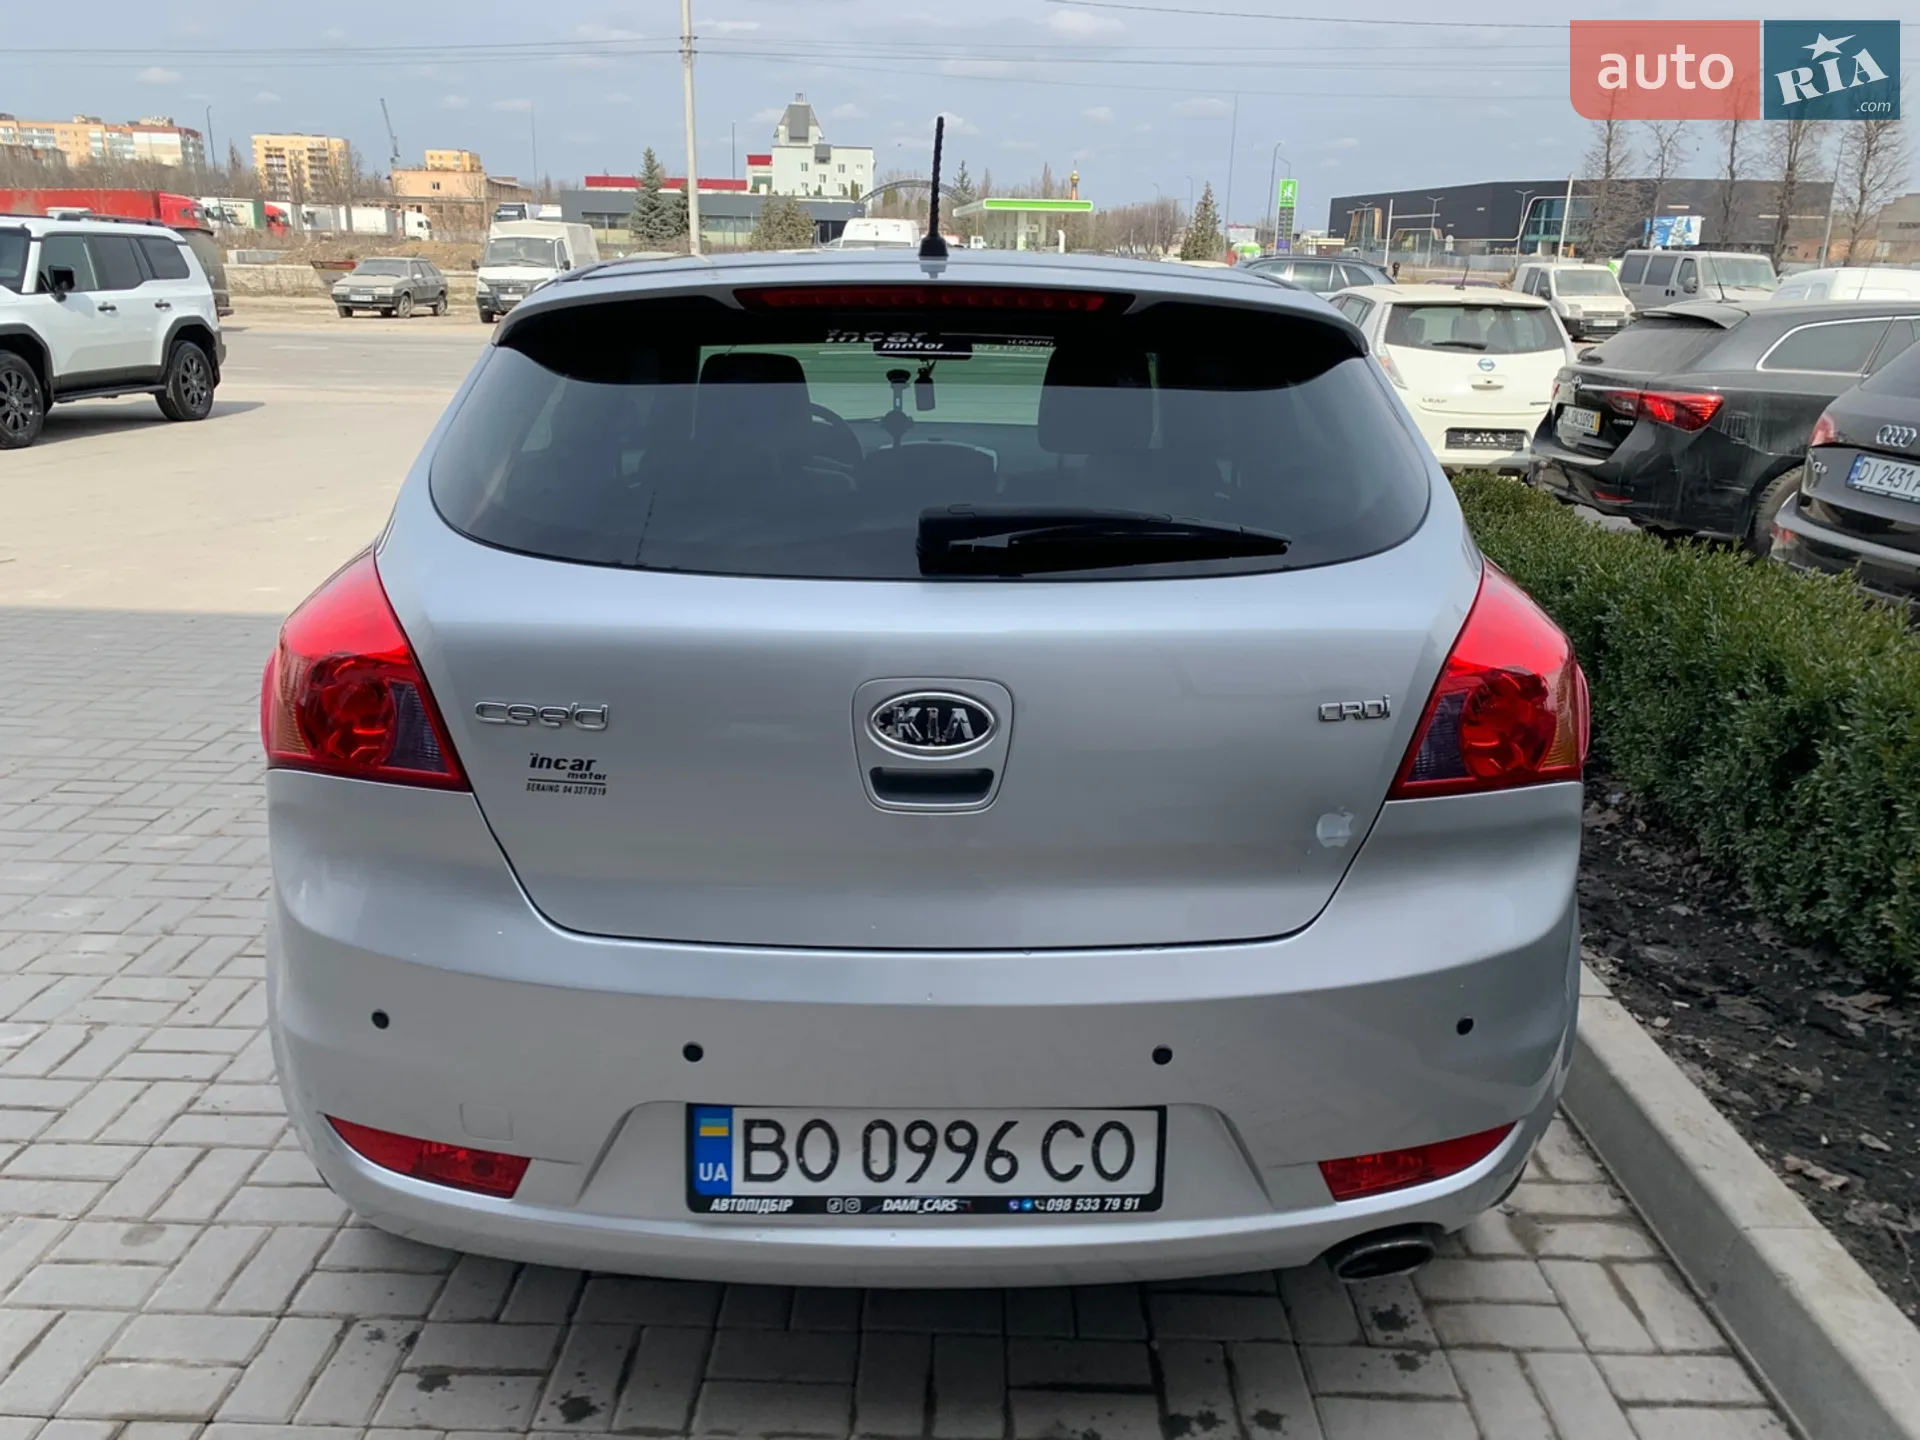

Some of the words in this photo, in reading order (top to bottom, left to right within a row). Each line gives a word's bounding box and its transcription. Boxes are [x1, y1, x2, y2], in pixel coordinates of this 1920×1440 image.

[1856, 460, 1879, 484] DI
[1876, 465, 1916, 491] 2431
[1319, 693, 1391, 721] CRDi
[893, 706, 975, 743] KIA
[567, 771, 607, 781] motor
[525, 782, 560, 793] SERAING
[742, 1118, 840, 1183] BO
[861, 1118, 1019, 1184] 0996
[1040, 1119, 1135, 1183] CO
[698, 1162, 729, 1182] UA
[709, 1198, 794, 1214] АВТОПІДБІР
[881, 1198, 958, 1214] DAMI_CARS
[1046, 1197, 1073, 1212] 098
[1074, 1197, 1100, 1212] 533
[1103, 1197, 1122, 1212] 79
[1123, 1197, 1141, 1212] 91
